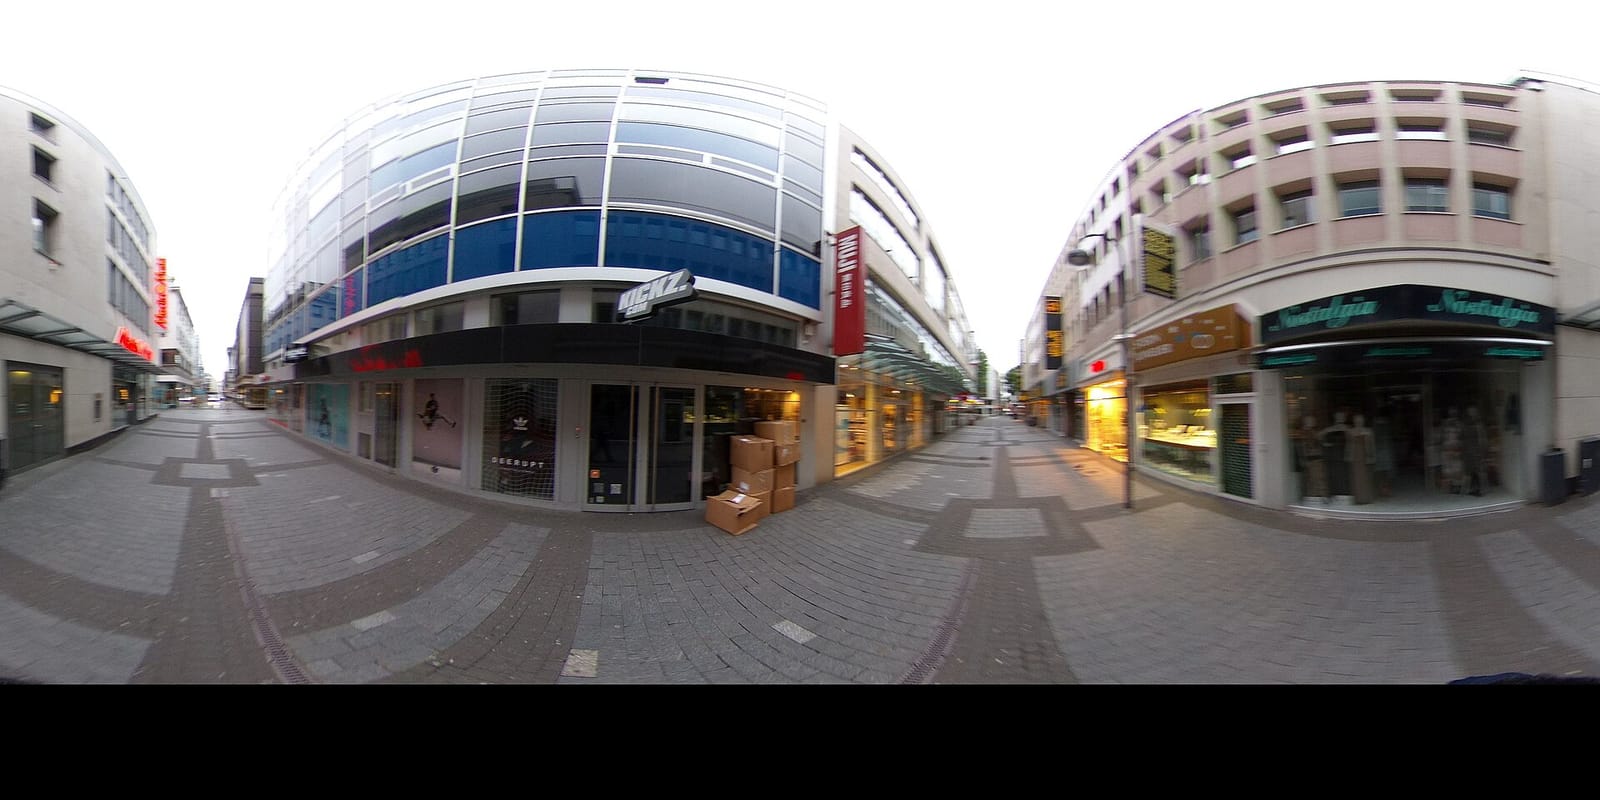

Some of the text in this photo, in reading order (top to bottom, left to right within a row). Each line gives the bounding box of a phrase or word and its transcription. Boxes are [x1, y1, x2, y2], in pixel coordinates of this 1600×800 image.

[837, 233, 858, 274] MUJI
[1267, 295, 1380, 331] Nostalgia
[1426, 289, 1540, 328] Nostalgia
